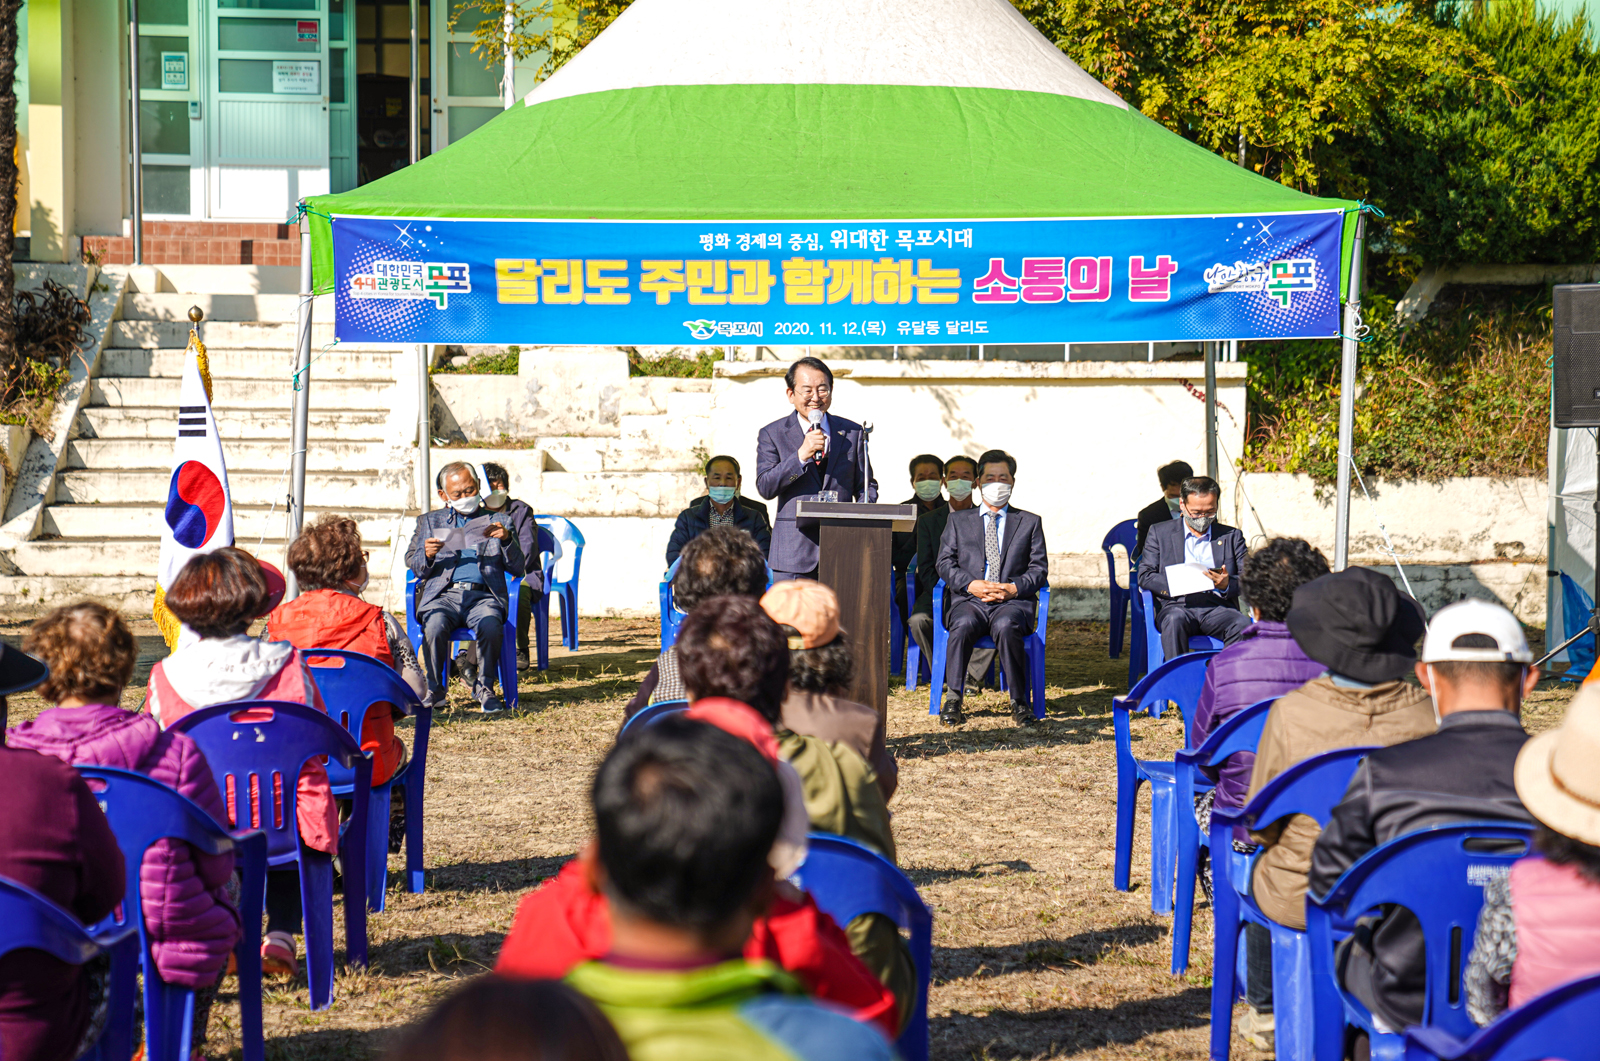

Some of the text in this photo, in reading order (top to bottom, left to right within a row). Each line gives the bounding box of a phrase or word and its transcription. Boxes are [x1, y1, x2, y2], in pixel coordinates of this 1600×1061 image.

[699, 228, 973, 252] 평화 경제의 중심, 위대한 목포시대
[377, 264, 468, 306] 대한민국 목포
[495, 255, 1178, 305] 달리도 주민과 함께하는 소통의 날
[1268, 262, 1313, 306] 목포
[718, 320, 990, 337] 목포시 2020. 11. 12.(목) 유달동 달리도
